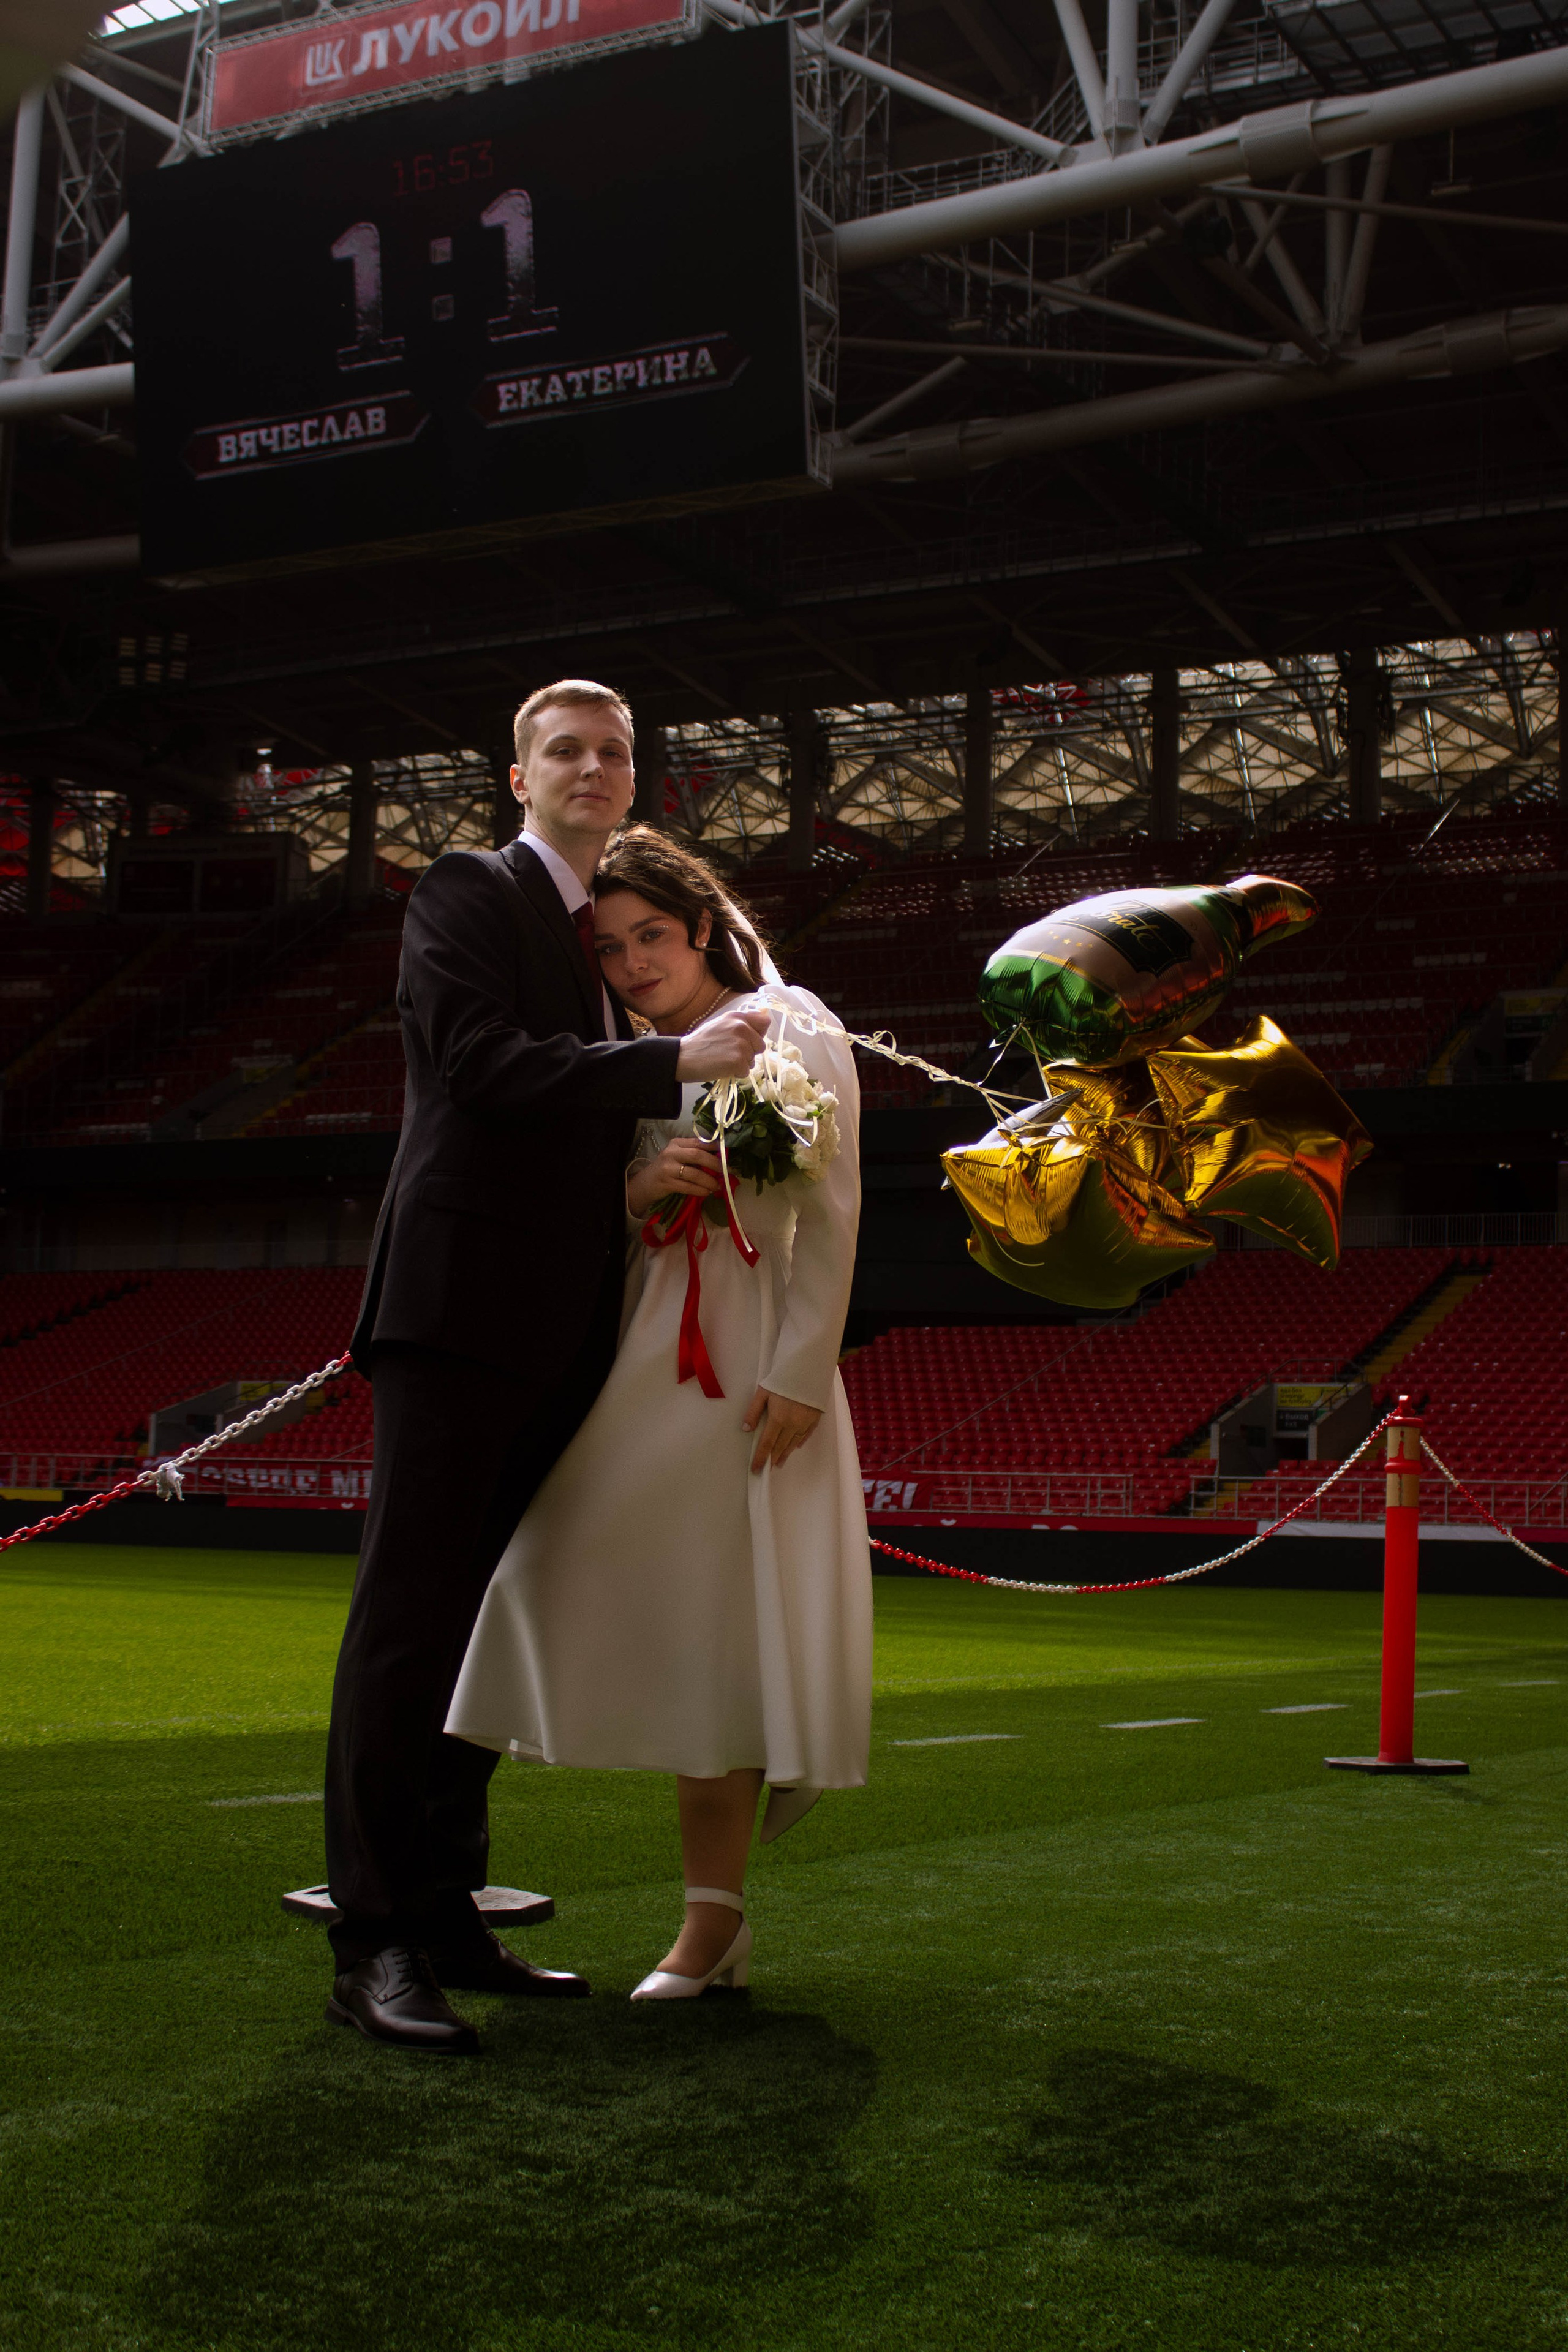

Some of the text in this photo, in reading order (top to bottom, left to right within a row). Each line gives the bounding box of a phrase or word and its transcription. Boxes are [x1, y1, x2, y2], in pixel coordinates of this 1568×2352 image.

[392, 140, 494, 197] 16:53
[497, 346, 718, 414] ЕКАТЕРИНА
[216, 405, 388, 465] ВЯЧЕСЛАВ
